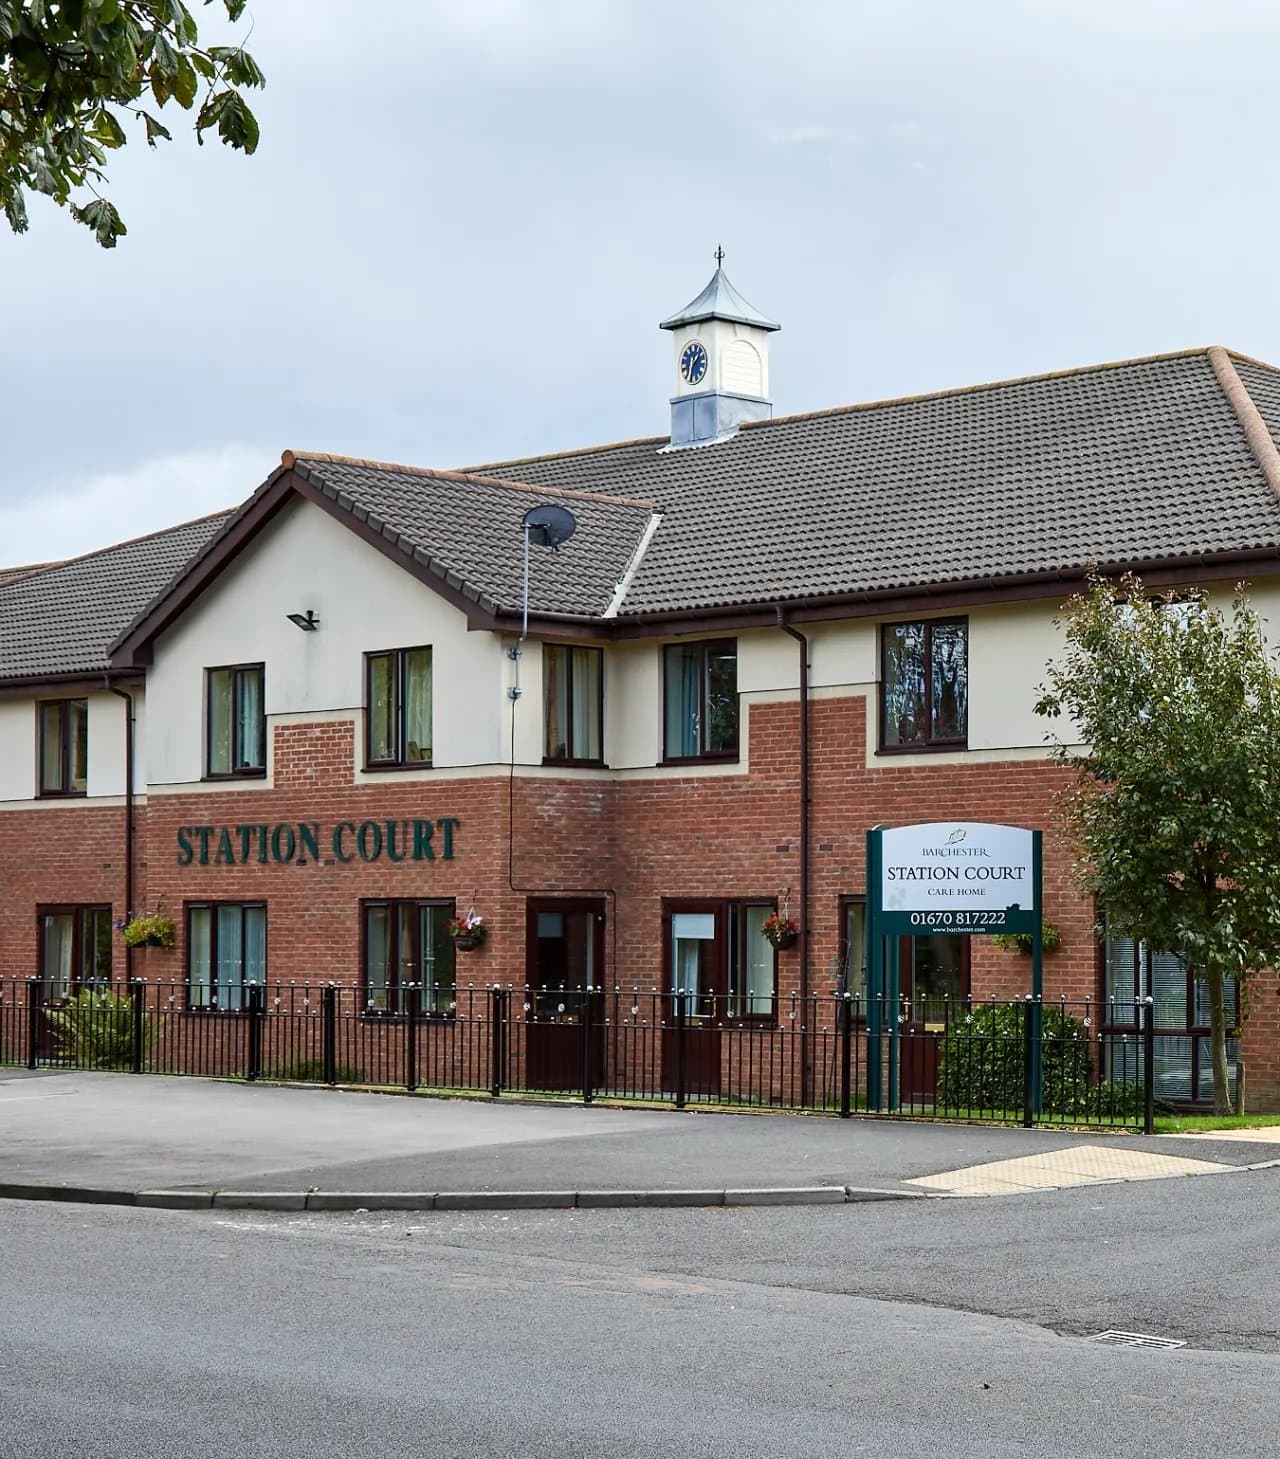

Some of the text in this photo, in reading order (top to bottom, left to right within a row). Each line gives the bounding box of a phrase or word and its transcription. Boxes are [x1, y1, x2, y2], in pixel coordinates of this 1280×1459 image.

[177, 818, 460, 865] STATION COURT
[922, 848, 991, 857] BARCHESTER
[887, 866, 1026, 880] STATION COURT
[927, 888, 986, 896] CARE HOME
[910, 912, 1006, 925] 01670 817222
